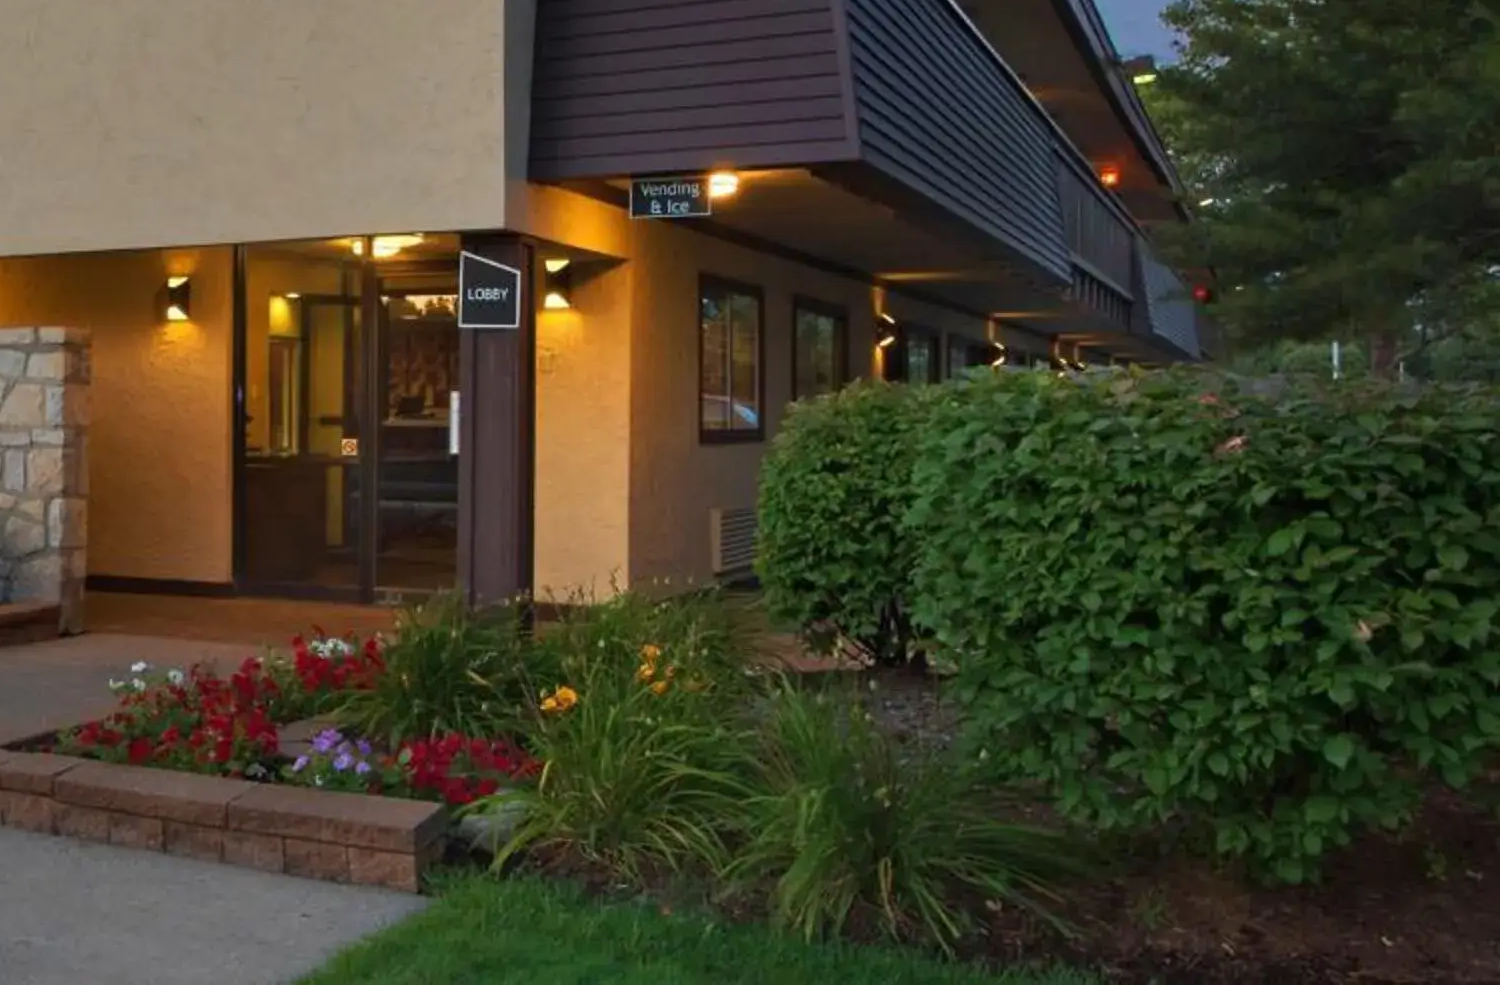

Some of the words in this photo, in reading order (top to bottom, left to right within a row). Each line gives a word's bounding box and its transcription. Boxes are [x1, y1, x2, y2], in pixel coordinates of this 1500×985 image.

[641, 182, 700, 197] Vending
[651, 200, 661, 214] &
[667, 199, 690, 213] Ice
[467, 287, 508, 301] LOBBY
